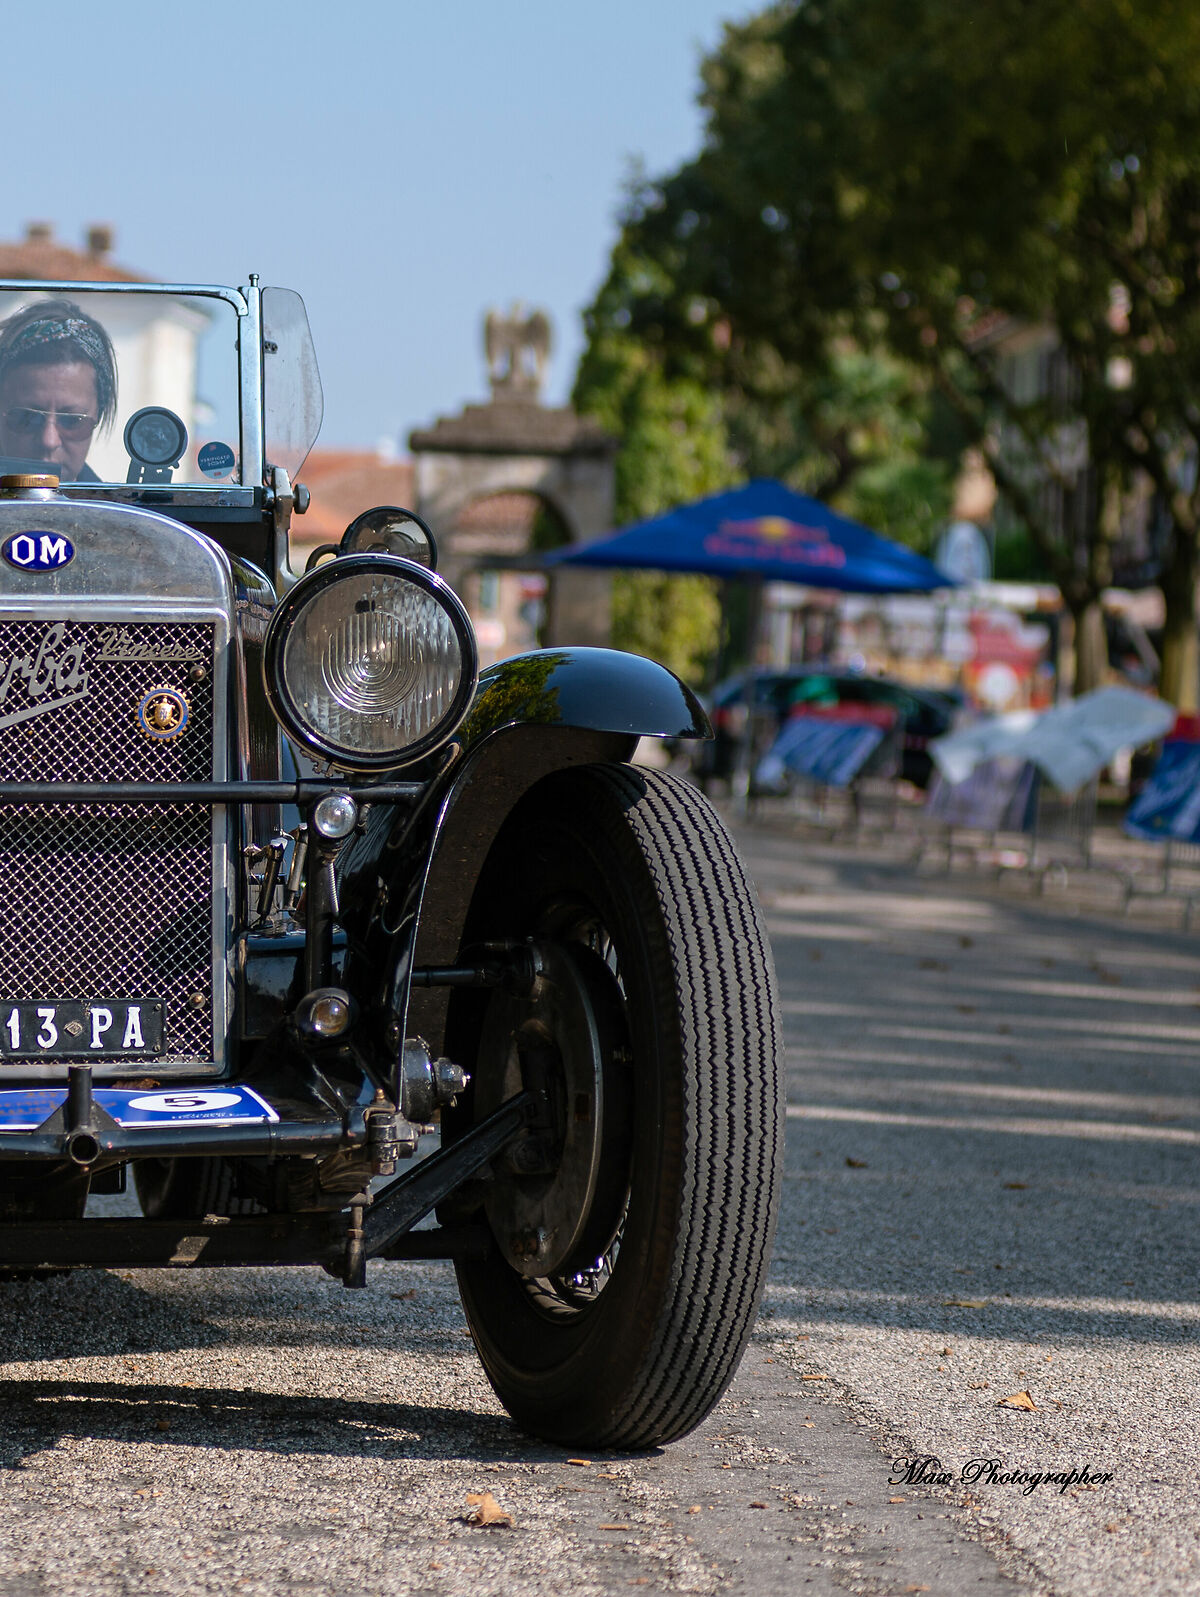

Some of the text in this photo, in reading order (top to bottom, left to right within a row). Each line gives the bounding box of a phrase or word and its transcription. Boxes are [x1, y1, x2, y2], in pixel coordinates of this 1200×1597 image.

[11, 535, 68, 565] OM
[95, 627, 204, 659] Vincere
[90, 1006, 145, 1049] PA
[163, 1096, 208, 1108] 5
